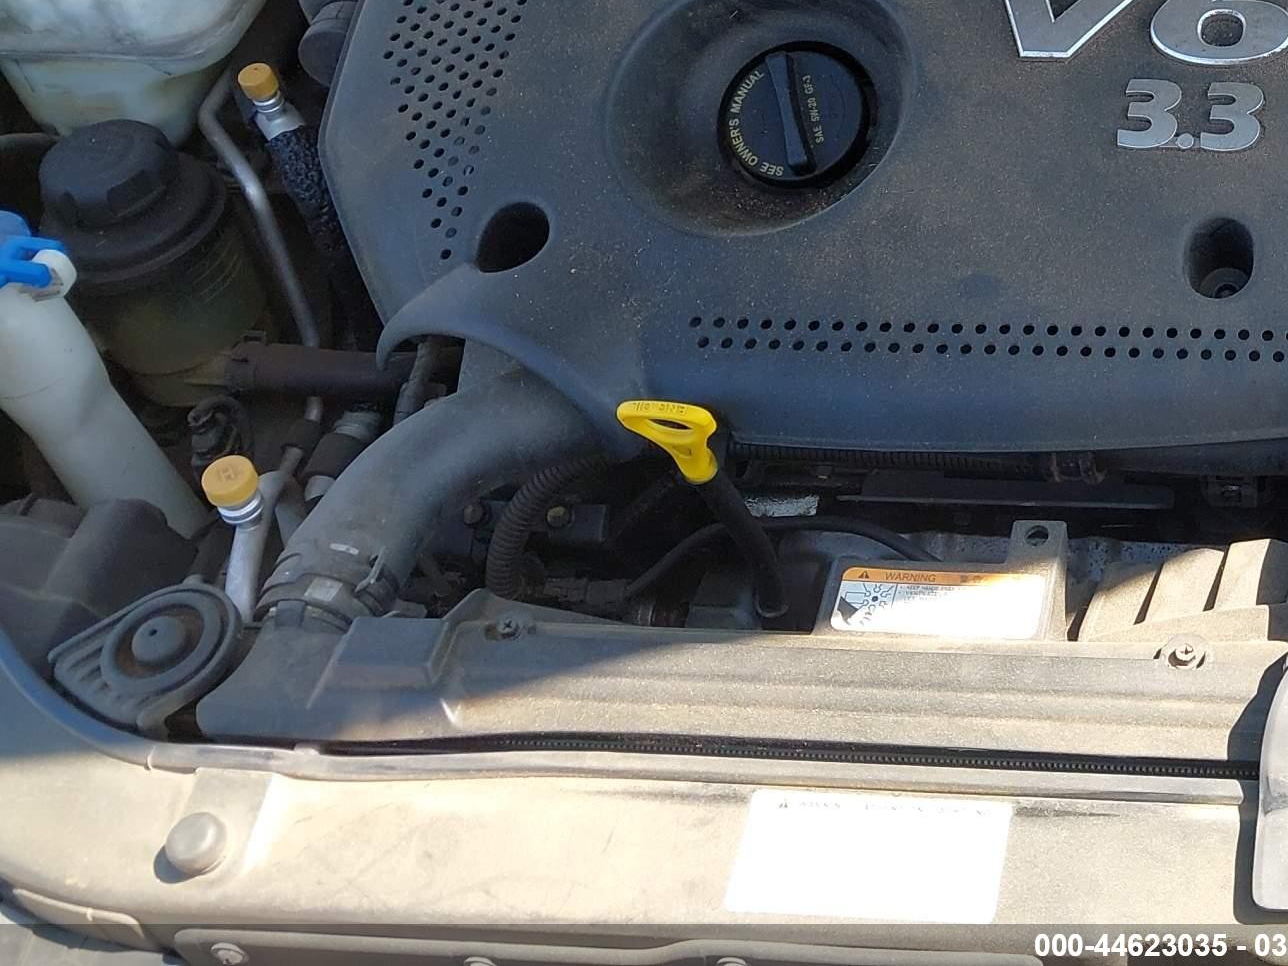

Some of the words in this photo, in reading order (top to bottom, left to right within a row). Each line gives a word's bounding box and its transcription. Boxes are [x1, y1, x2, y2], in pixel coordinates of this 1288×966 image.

[730, 70, 764, 114] MANUAL
[807, 97, 820, 122] 5W-20
[1117, 78, 1266, 151] 3.3
[728, 118, 758, 166] OWNER'S
[813, 125, 824, 144] SAE
[760, 161, 784, 177] SEE
[885, 572, 936, 583] WARNING
